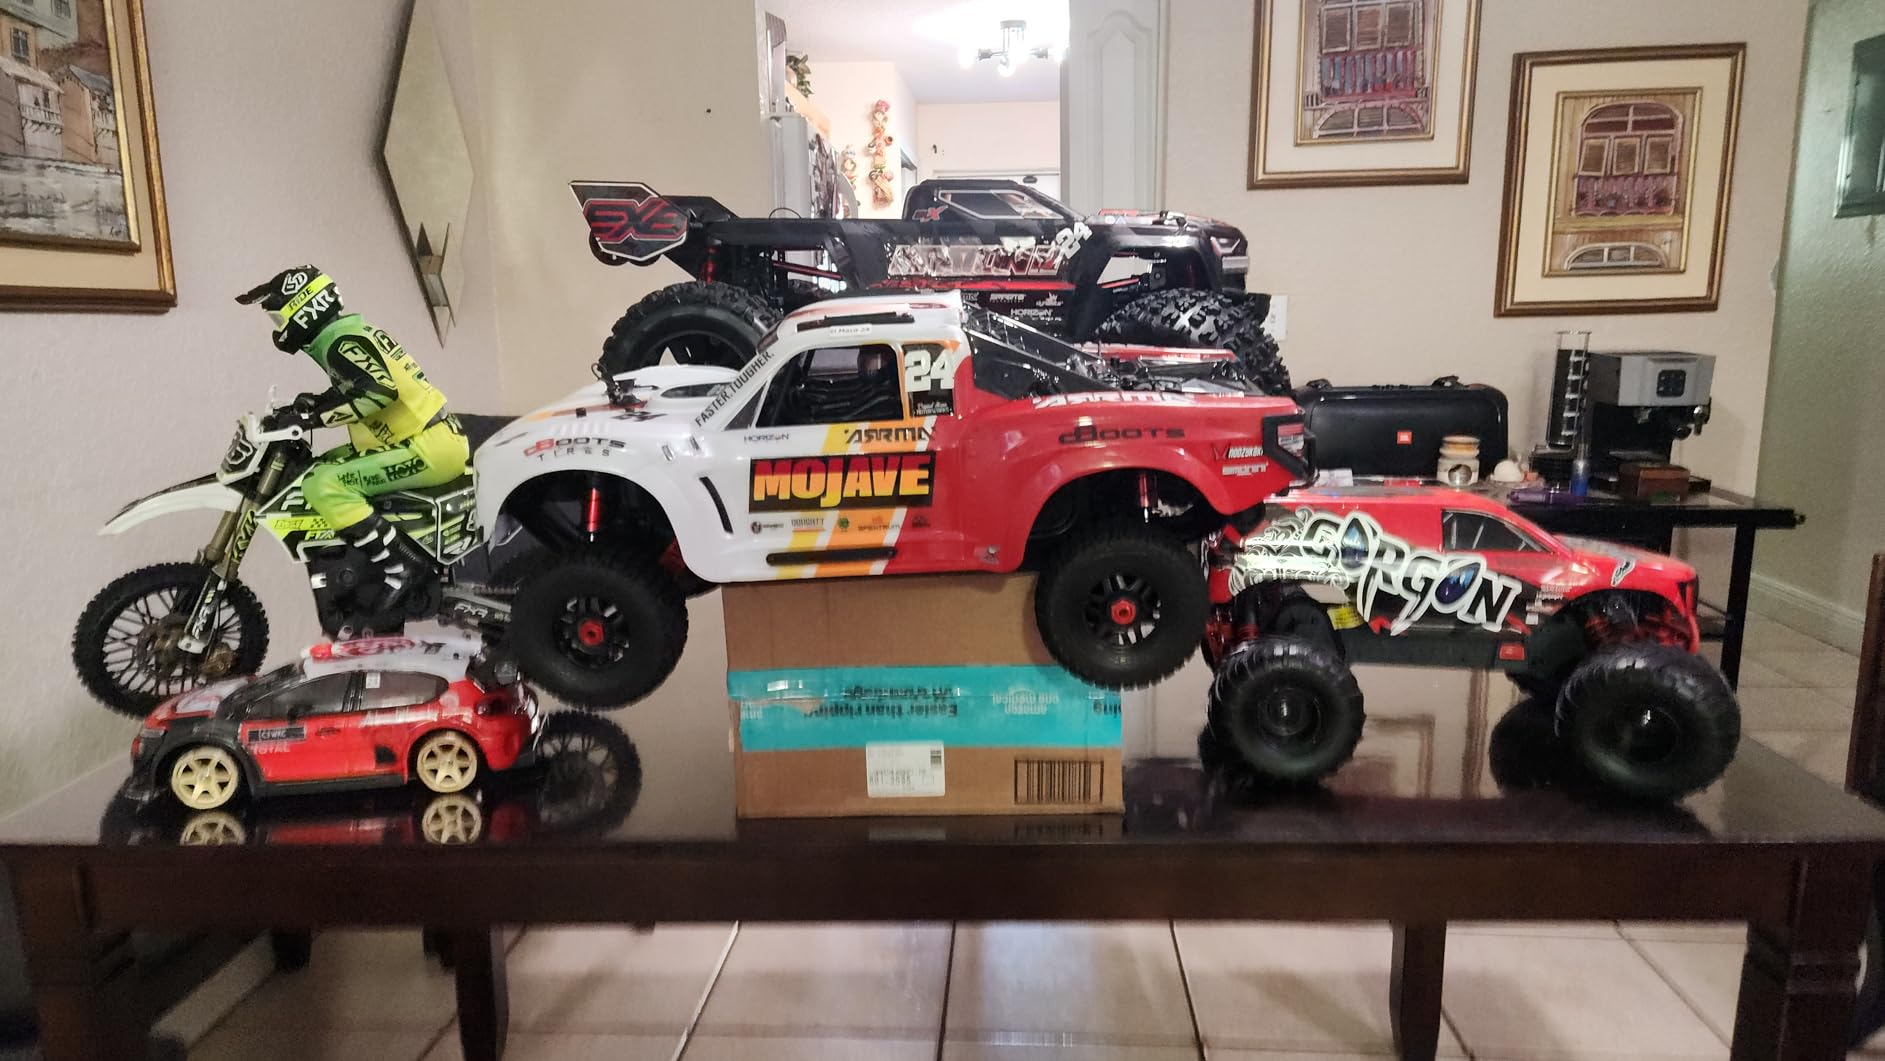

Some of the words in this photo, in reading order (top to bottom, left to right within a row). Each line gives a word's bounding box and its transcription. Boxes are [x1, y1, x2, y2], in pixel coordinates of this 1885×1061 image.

[1056, 221, 1093, 260] 24
[288, 285, 314, 311] RIDE
[292, 289, 335, 329] FXR
[904, 349, 954, 393] 24
[744, 433, 790, 442] HORIZON
[753, 455, 932, 508] MOJAVE
